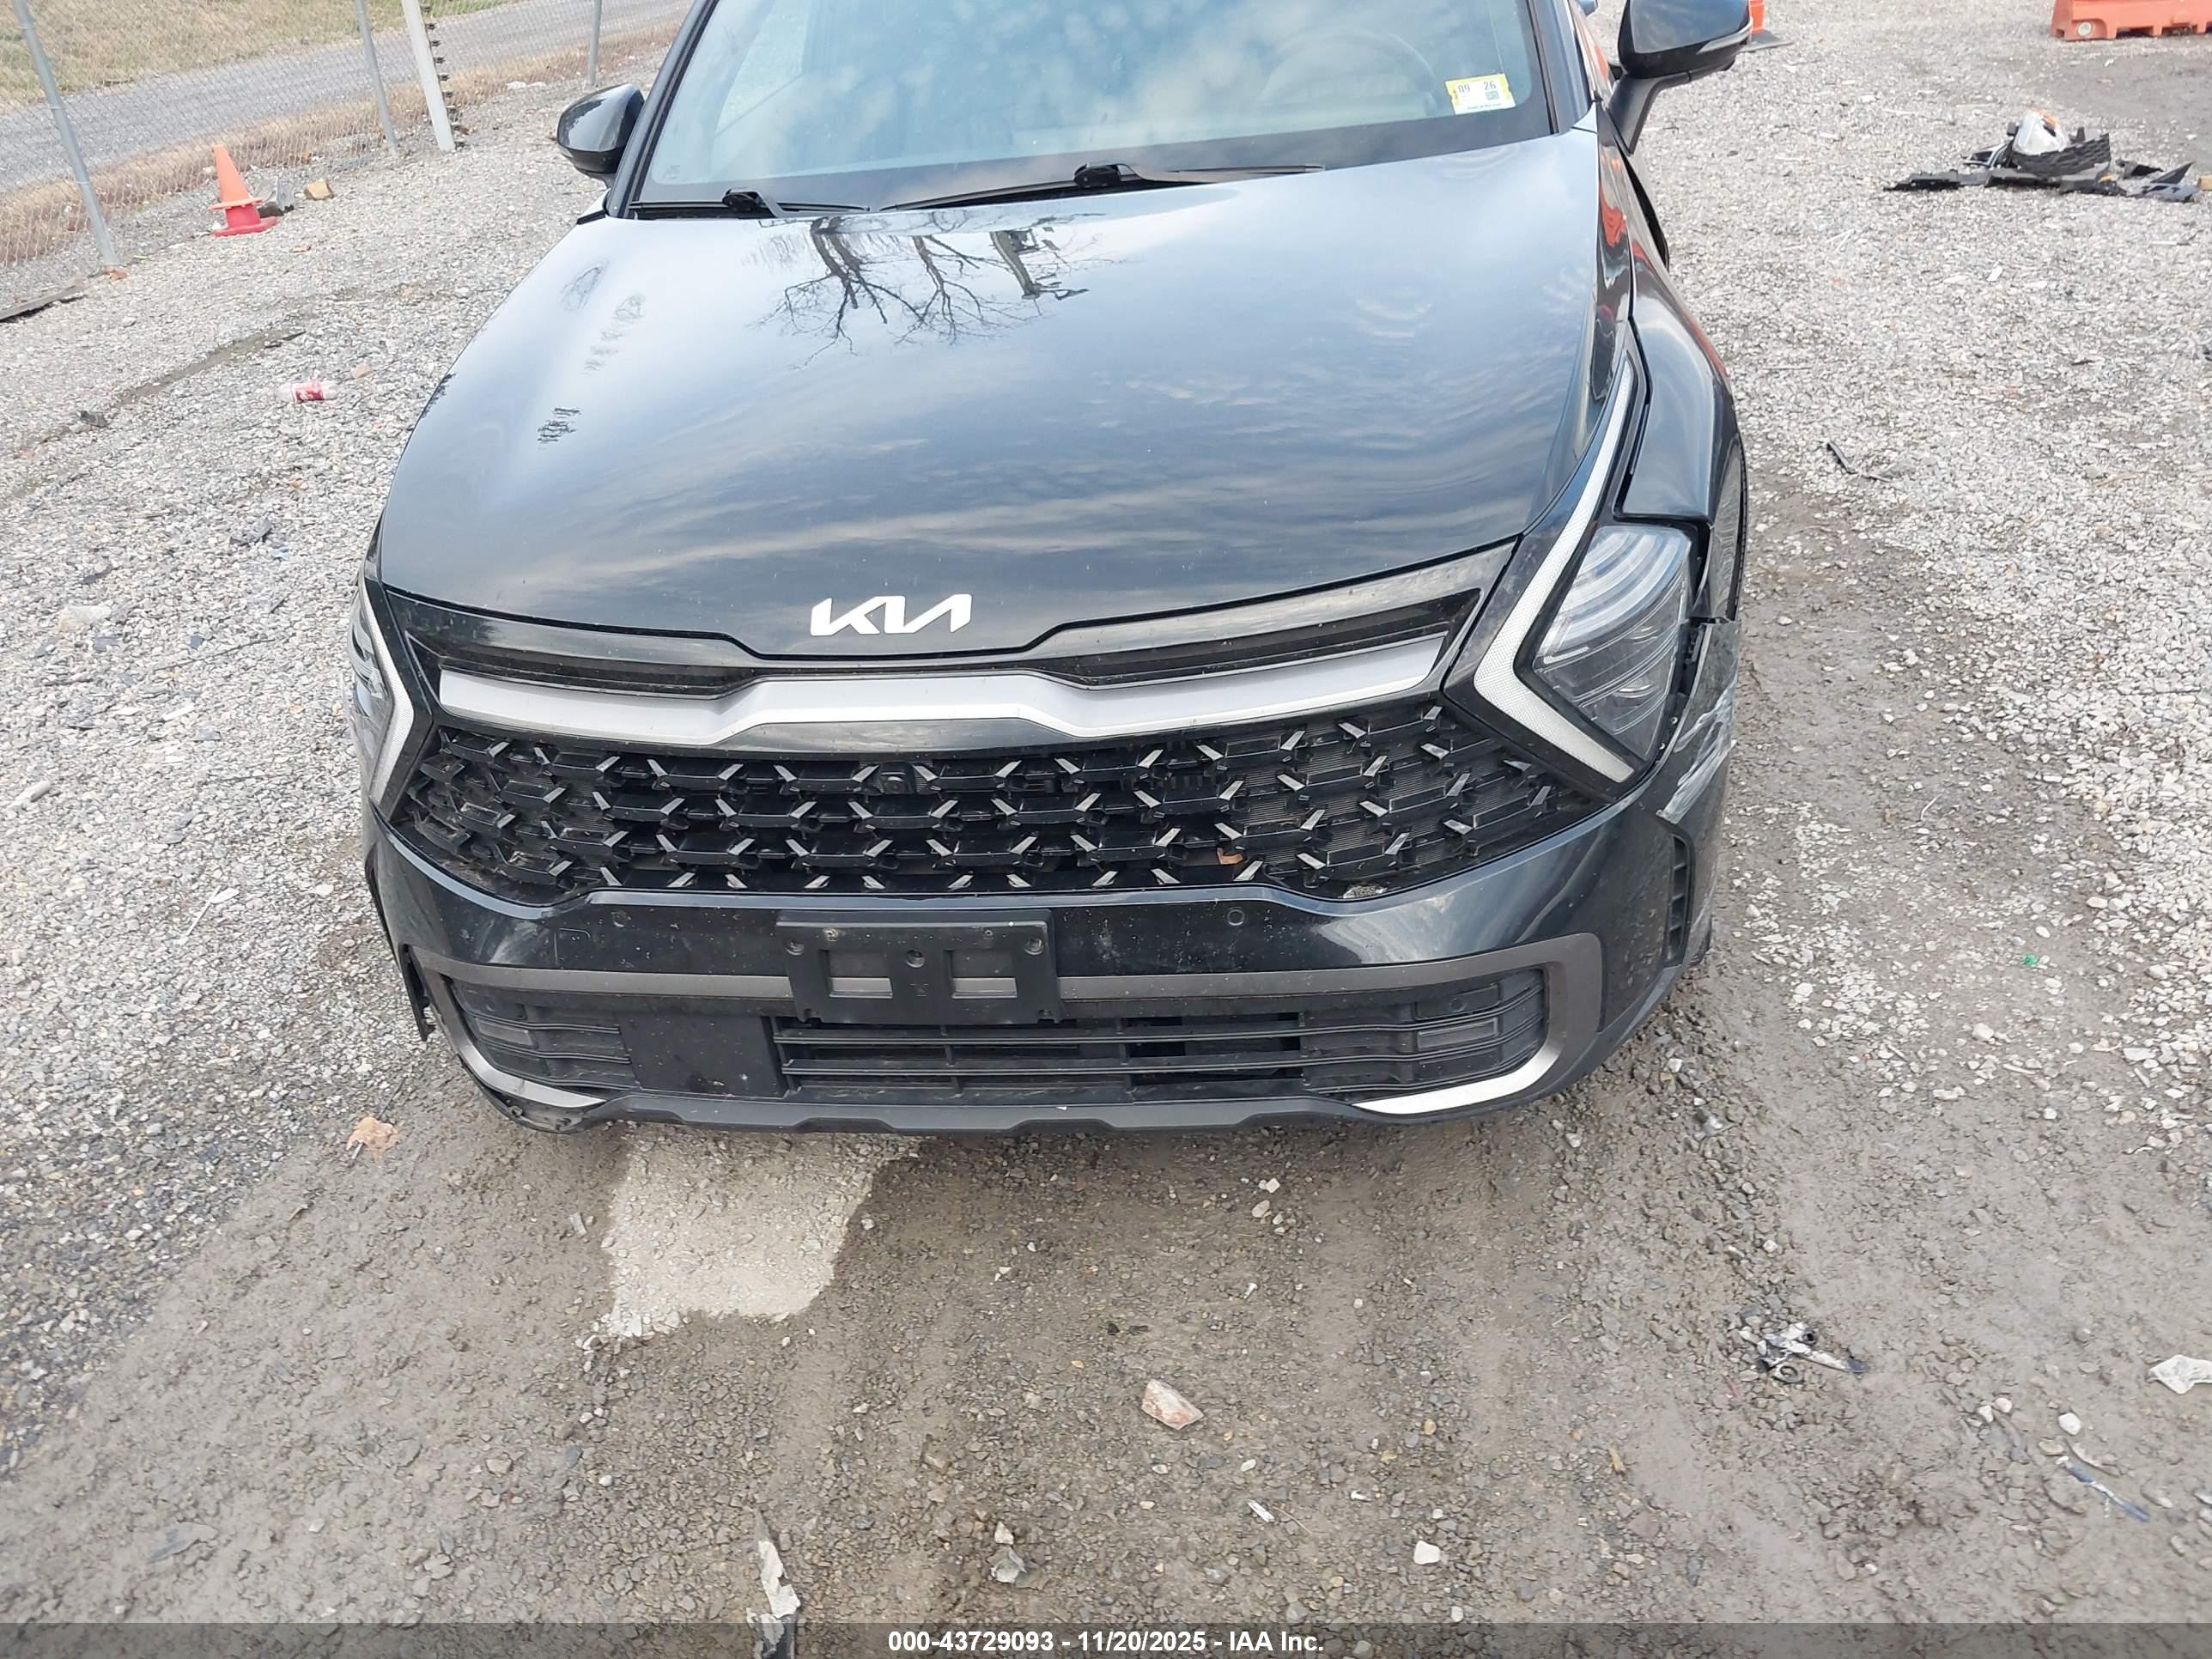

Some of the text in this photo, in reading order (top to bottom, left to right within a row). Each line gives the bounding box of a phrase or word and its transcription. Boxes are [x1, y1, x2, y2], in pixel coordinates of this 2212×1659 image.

[1458, 81, 1496, 93] 09 26
[810, 593, 972, 636] KIA
